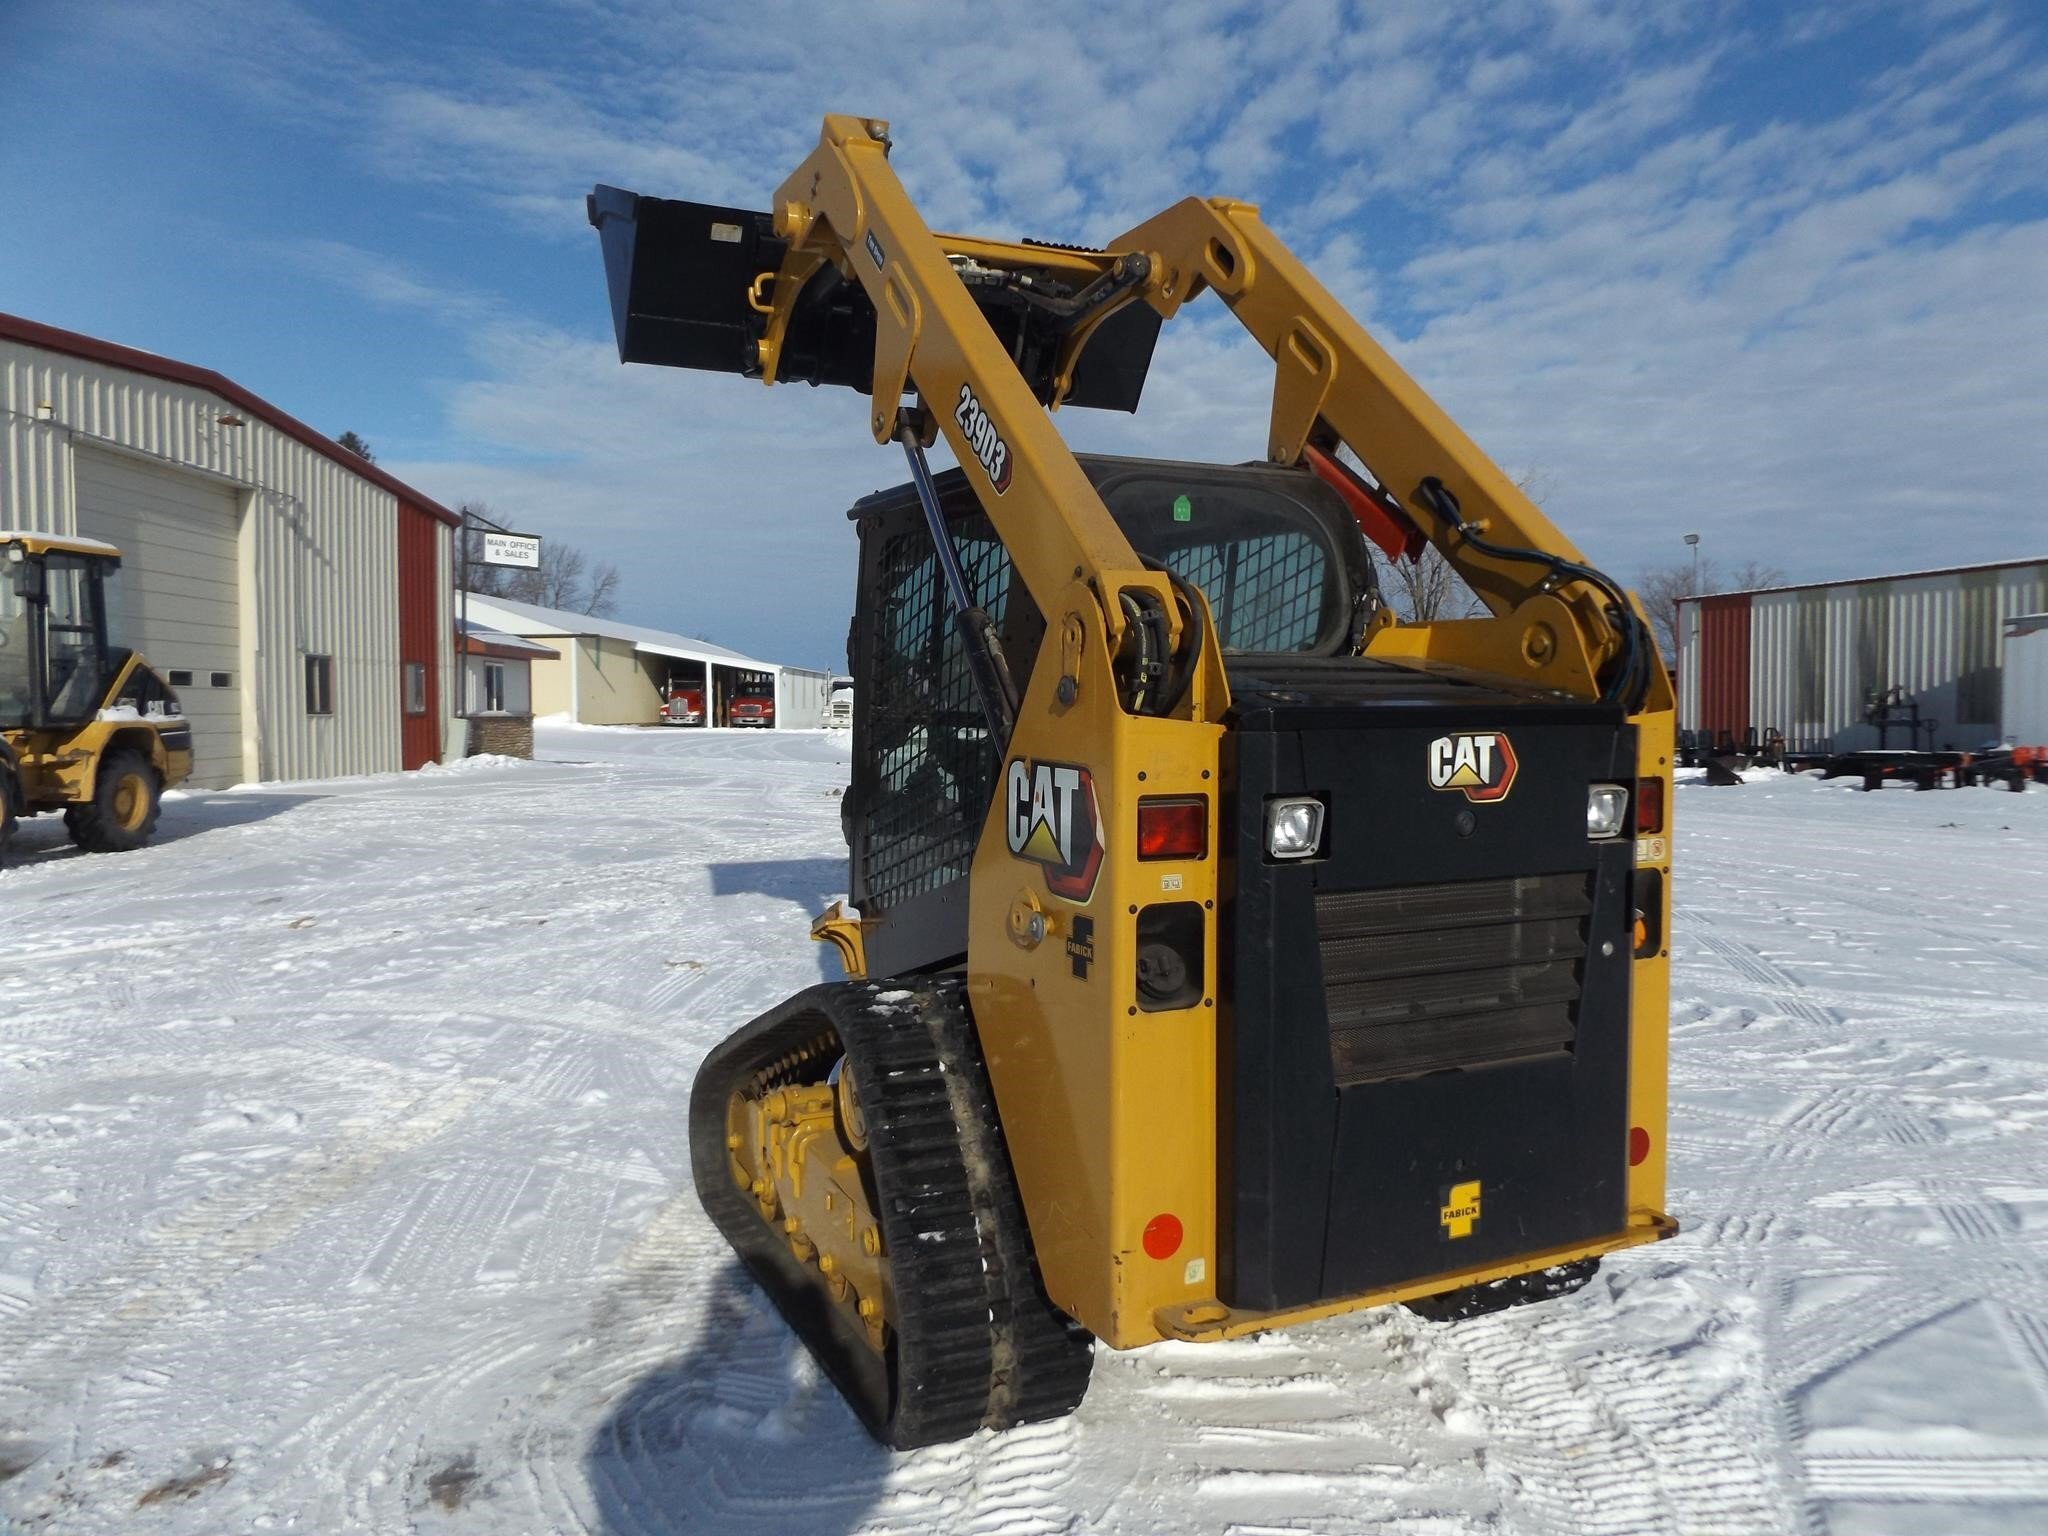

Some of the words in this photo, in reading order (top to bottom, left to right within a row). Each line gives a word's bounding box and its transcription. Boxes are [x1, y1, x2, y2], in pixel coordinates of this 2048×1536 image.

[954, 384, 1006, 482] 239D3
[487, 538, 507, 548] MAIN
[510, 541, 537, 551] OFFICE
[504, 549, 529, 559] SALES
[1430, 735, 1496, 787] CAT
[1008, 760, 1079, 867] CAT
[1067, 940, 1094, 959] FABICK
[1443, 1206, 1478, 1220] FABICK
